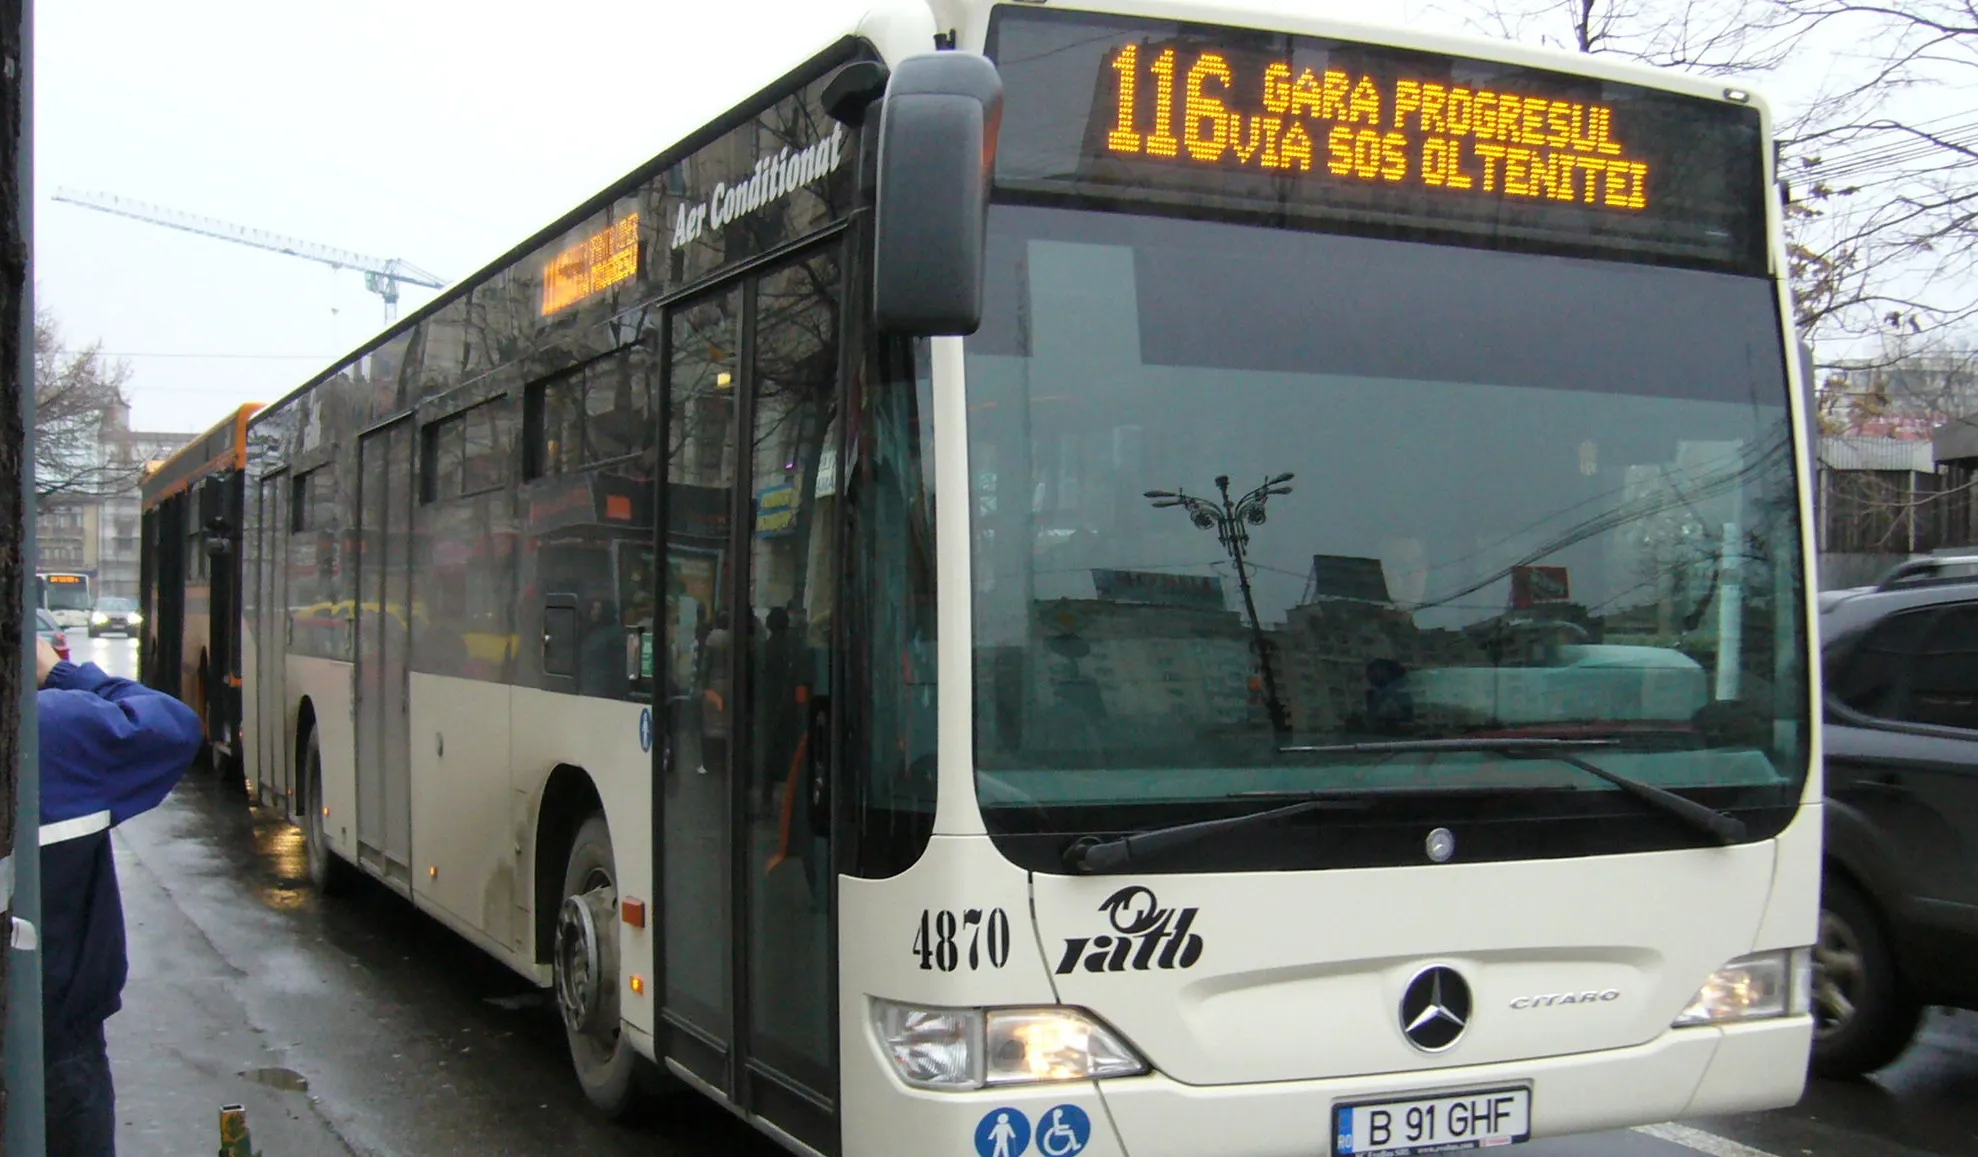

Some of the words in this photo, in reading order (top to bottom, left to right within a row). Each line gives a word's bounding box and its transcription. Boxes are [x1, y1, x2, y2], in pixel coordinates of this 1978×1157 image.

[1108, 44, 1231, 161] 116
[1263, 62, 1380, 125] GARA
[1394, 79, 1621, 155] PROGRESUL
[671, 203, 707, 249] Aer
[710, 121, 843, 230] Conditionat
[1229, 113, 1311, 171] VIA
[1327, 126, 1407, 181] SOS
[1421, 137, 1647, 208] OLTENITEI
[912, 907, 1010, 972] 4870
[1509, 988, 1621, 1010] CITARO
[1369, 1110, 1392, 1146] B
[1405, 1104, 1435, 1142] 91
[1448, 1096, 1515, 1137] GHF
